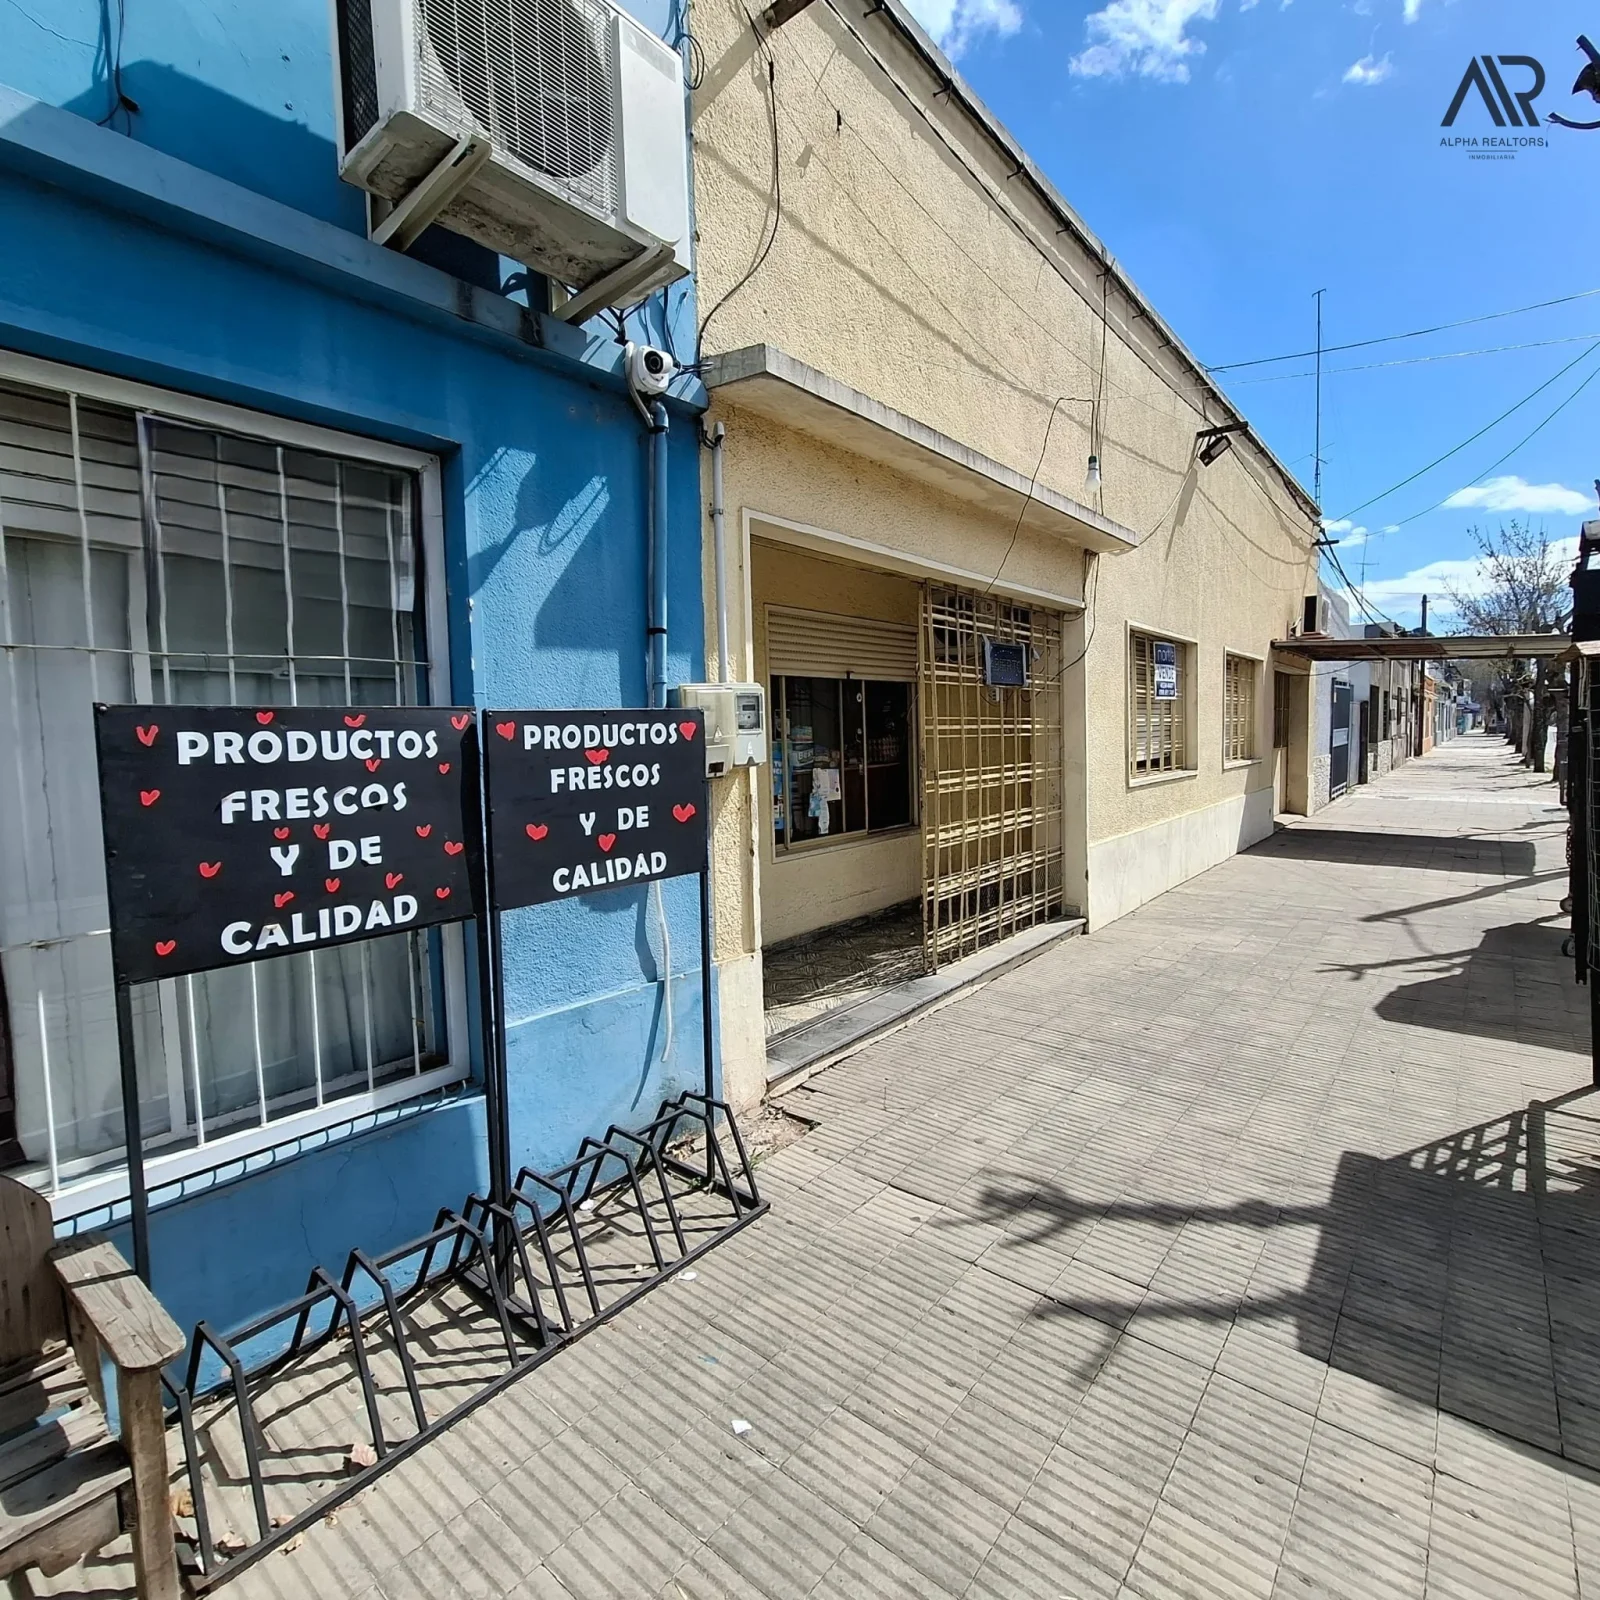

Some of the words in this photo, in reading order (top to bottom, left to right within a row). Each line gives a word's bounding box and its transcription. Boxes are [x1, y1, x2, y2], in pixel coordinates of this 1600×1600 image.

[176, 729, 439, 766] PRODUCTOS
[523, 722, 679, 750] PRODUCTOS
[550, 763, 661, 793] FRESCOS
[221, 781, 408, 824] FRESCOS
[579, 812, 596, 836] Y
[617, 805, 650, 831] DE
[270, 844, 300, 876] Y
[329, 835, 383, 871] DE
[552, 851, 667, 893] CALIDAD
[221, 895, 419, 955] CALIDAD
